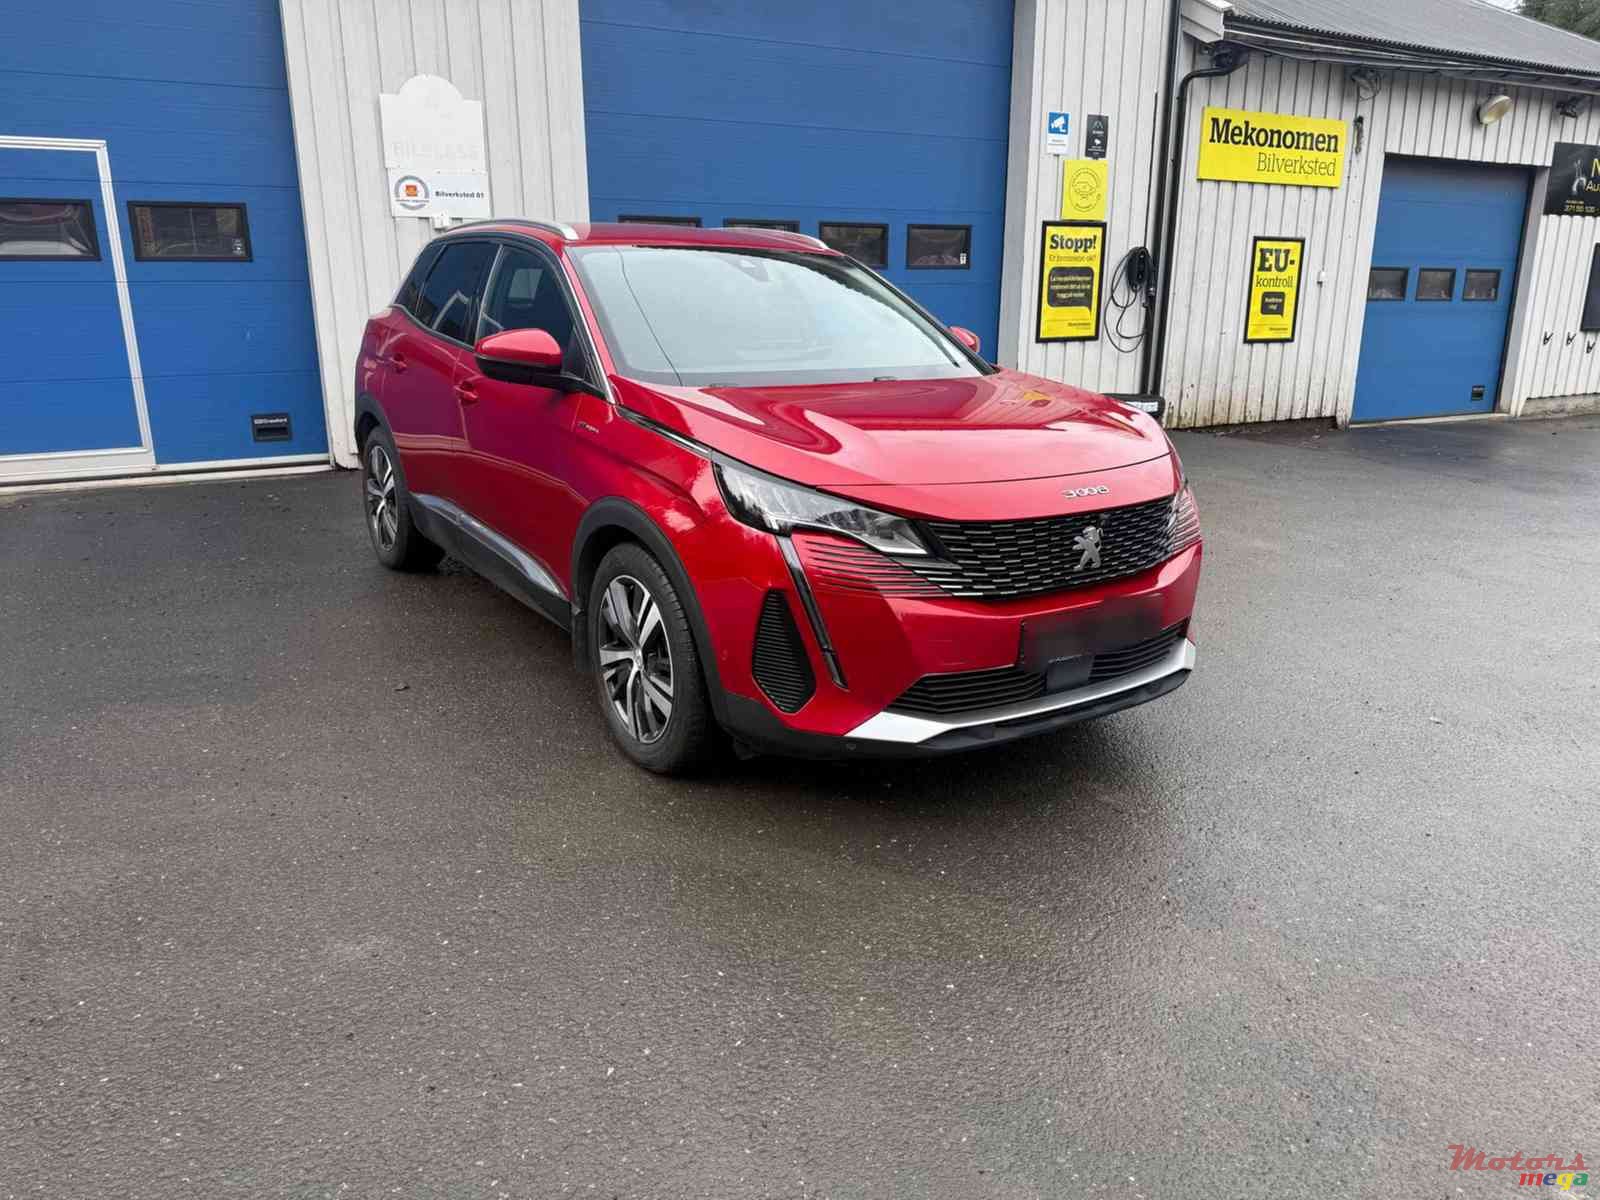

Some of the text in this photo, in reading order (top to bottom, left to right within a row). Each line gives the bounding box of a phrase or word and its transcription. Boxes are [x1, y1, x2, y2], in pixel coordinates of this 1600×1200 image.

[1209, 117, 1339, 152] Mekonomen
[1257, 152, 1337, 176] Bilverksted
[1049, 234, 1097, 252] Stopp!
[1257, 248, 1295, 272] EU-
[1255, 275, 1294, 288] kontroll
